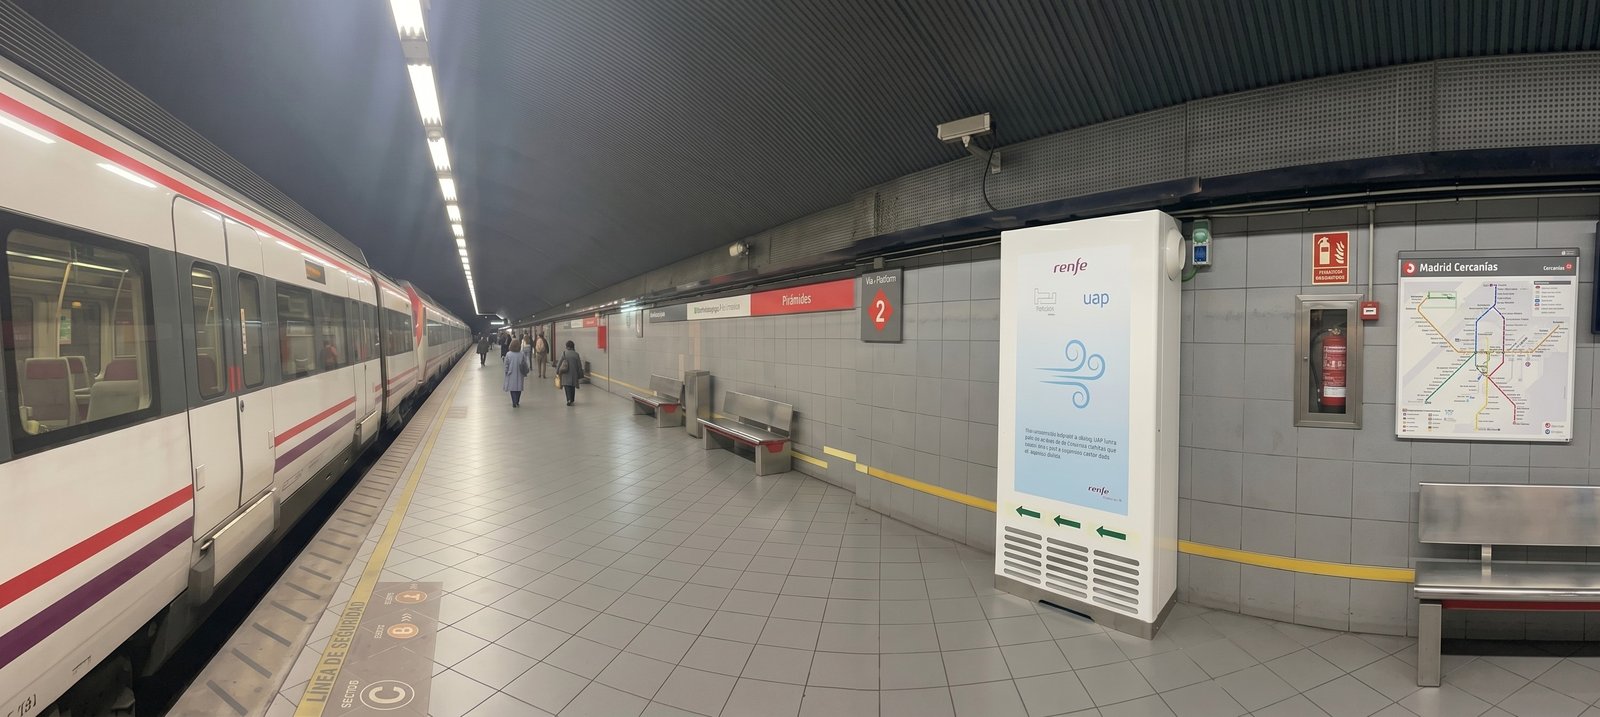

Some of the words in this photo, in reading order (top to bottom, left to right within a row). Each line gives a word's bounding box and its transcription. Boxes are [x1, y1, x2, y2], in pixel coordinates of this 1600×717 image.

[1053, 257, 1088, 276] renfe
[1419, 262, 1452, 272] Madrid
[1454, 261, 1499, 272] Cercanías
[782, 293, 812, 306] Pirámides
[1083, 292, 1110, 308] uap
[875, 299, 885, 323] 2
[1088, 485, 1110, 496] renfe
[331, 601, 366, 649] SEGURIDAD
[392, 626, 414, 635] B
[323, 651, 345, 666] DE
[306, 667, 338, 703] LÍNEA
[368, 686, 406, 704] C
